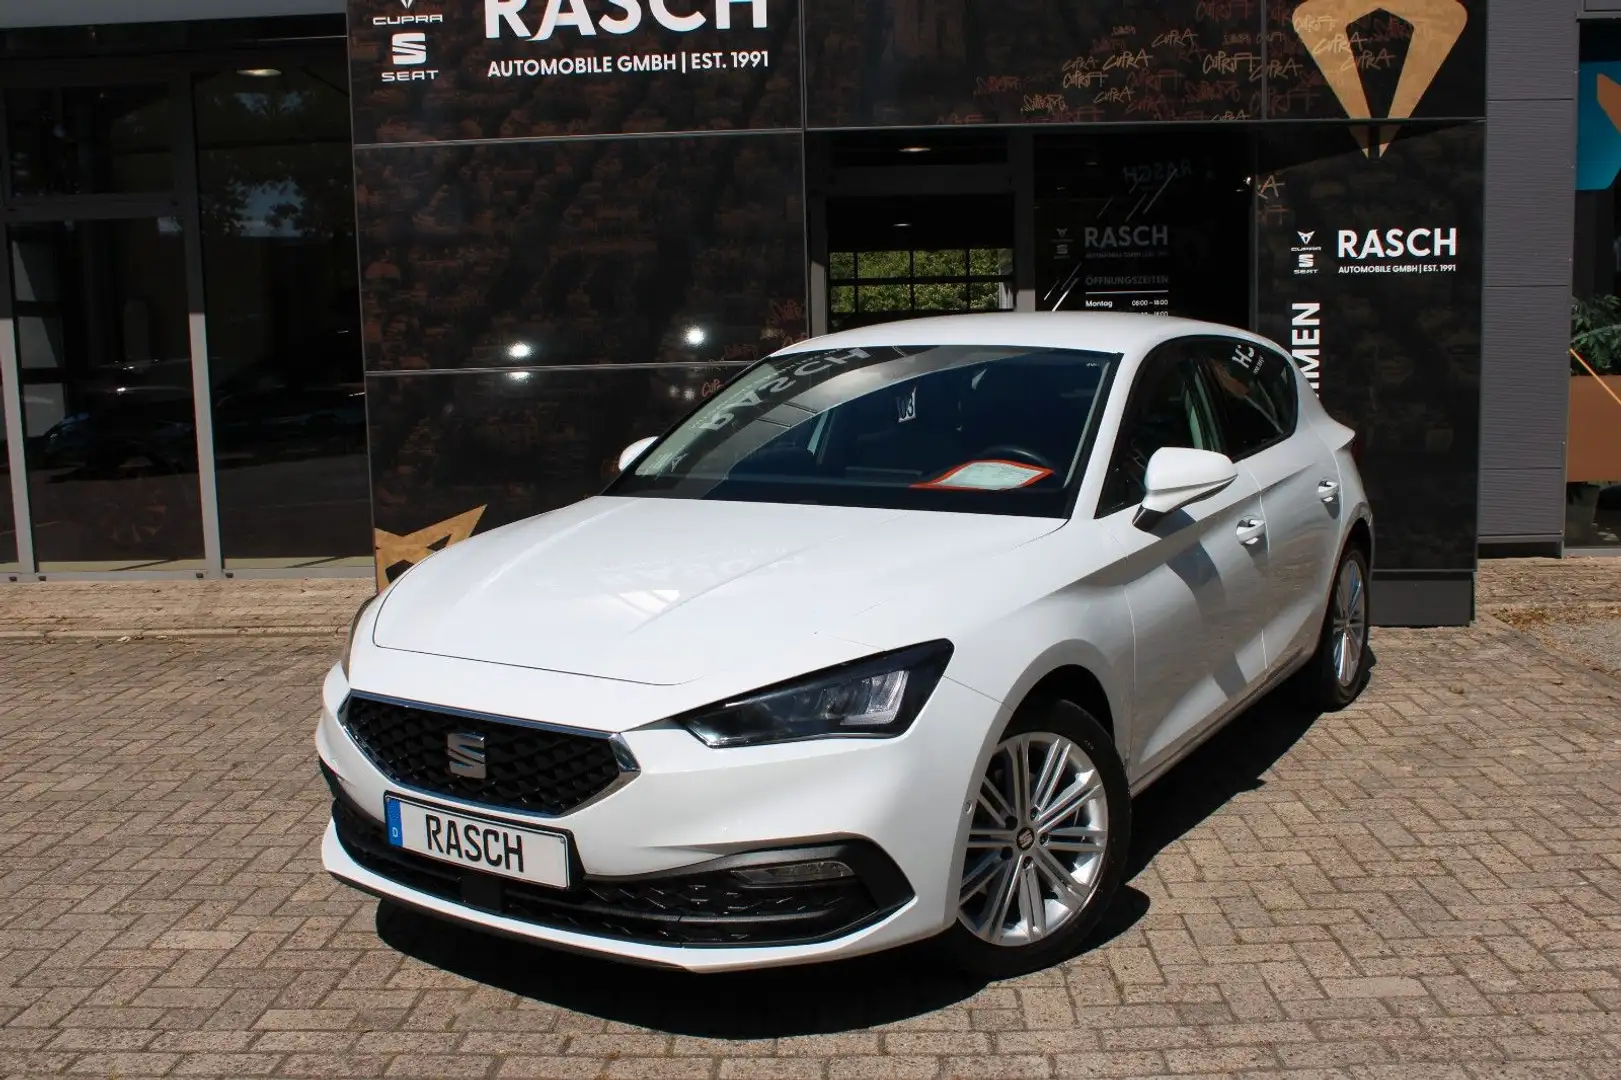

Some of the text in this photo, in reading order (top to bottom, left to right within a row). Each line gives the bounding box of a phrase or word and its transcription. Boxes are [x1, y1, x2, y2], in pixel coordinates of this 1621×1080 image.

[372, 14, 443, 25] CUPRA
[487, 57, 612, 77] AUTOMOBILE
[617, 54, 676, 72] GMBH
[691, 52, 727, 70] EST.
[730, 51, 769, 68] 1991
[381, 70, 439, 82] SEAT
[1084, 225, 1168, 248] RASCH
[1337, 227, 1457, 259] RASCH
[1338, 265, 1391, 273] AUTOMOBILE
[1392, 264, 1418, 272] GMBH
[1423, 264, 1439, 272] EST.
[1440, 264, 1456, 272] 1991
[1085, 274, 1169, 286] ÖFFNUNGSZEITEN
[1085, 299, 1113, 309] Montag
[1292, 303, 1321, 400] MEN
[425, 813, 524, 873] RASCH
